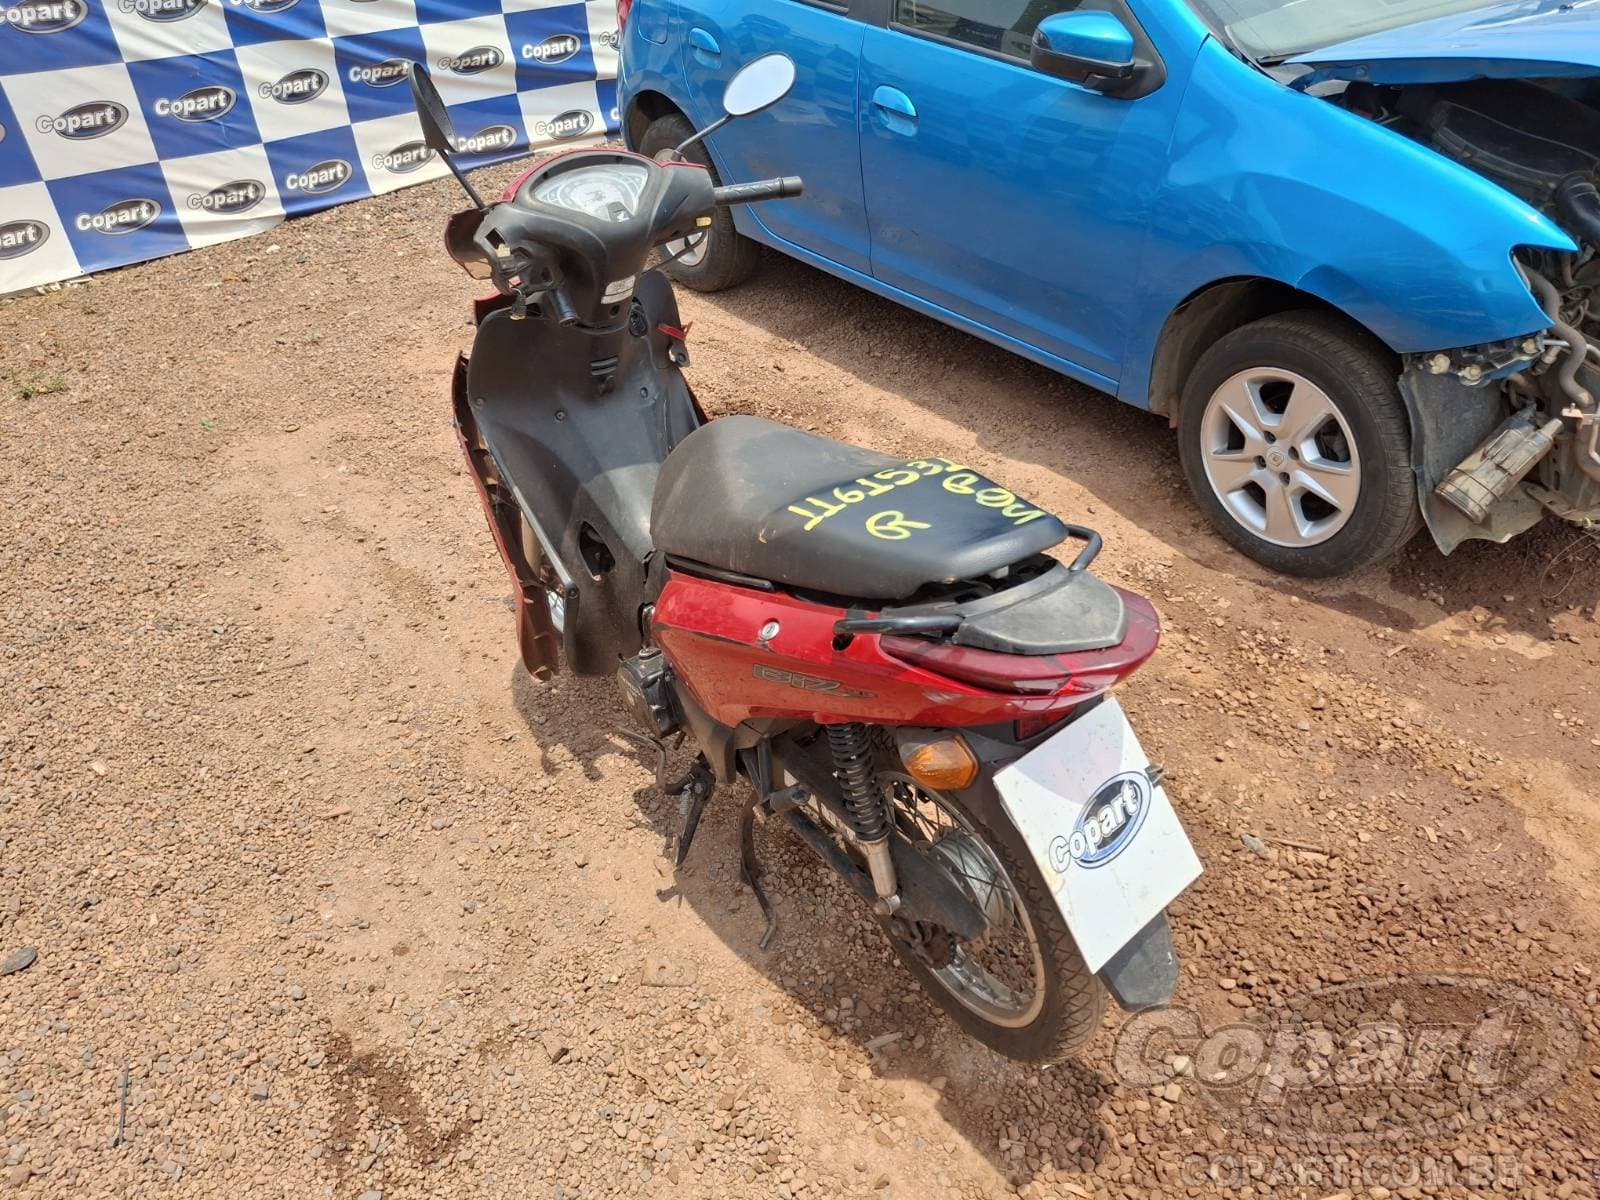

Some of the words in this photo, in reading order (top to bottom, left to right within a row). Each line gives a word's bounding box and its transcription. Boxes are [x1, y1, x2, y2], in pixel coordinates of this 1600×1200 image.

[437, 50, 496, 70] Copart
[522, 38, 574, 59] Copart
[349, 61, 409, 83] Copart
[257, 73, 320, 99] Copart
[153, 91, 228, 117] Copart
[35, 106, 116, 134] Copart
[535, 112, 587, 136] Copart
[457, 130, 510, 152] Copart
[371, 145, 428, 170] Copart
[286, 163, 344, 190] Copart
[186, 183, 256, 210] Copart
[76, 202, 150, 231] Copart
[1049, 779, 1141, 874] Copart
